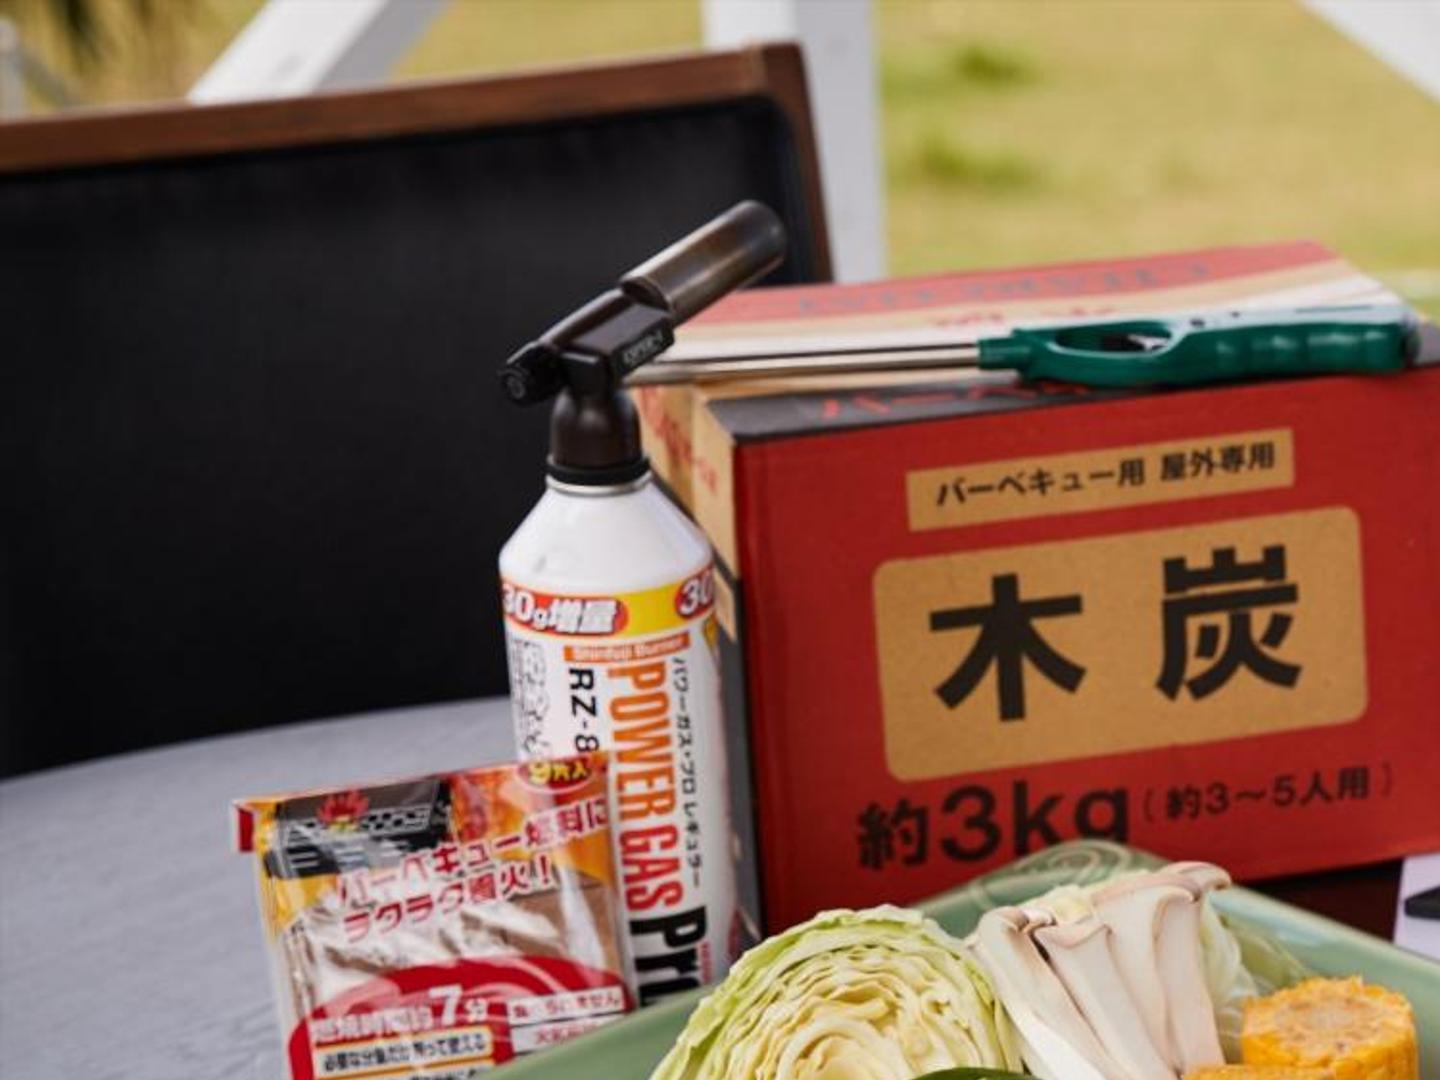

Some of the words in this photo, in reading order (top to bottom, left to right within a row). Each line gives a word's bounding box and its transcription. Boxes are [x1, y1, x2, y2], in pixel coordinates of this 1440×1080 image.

[935, 458, 1146, 507] バーベキュー用
[1160, 441, 1275, 482] 屋外専用
[928, 544, 1303, 723] 木炭
[607, 661, 678, 821] POWER
[618, 824, 684, 912] GAS
[857, 780, 1130, 870] 約3kg
